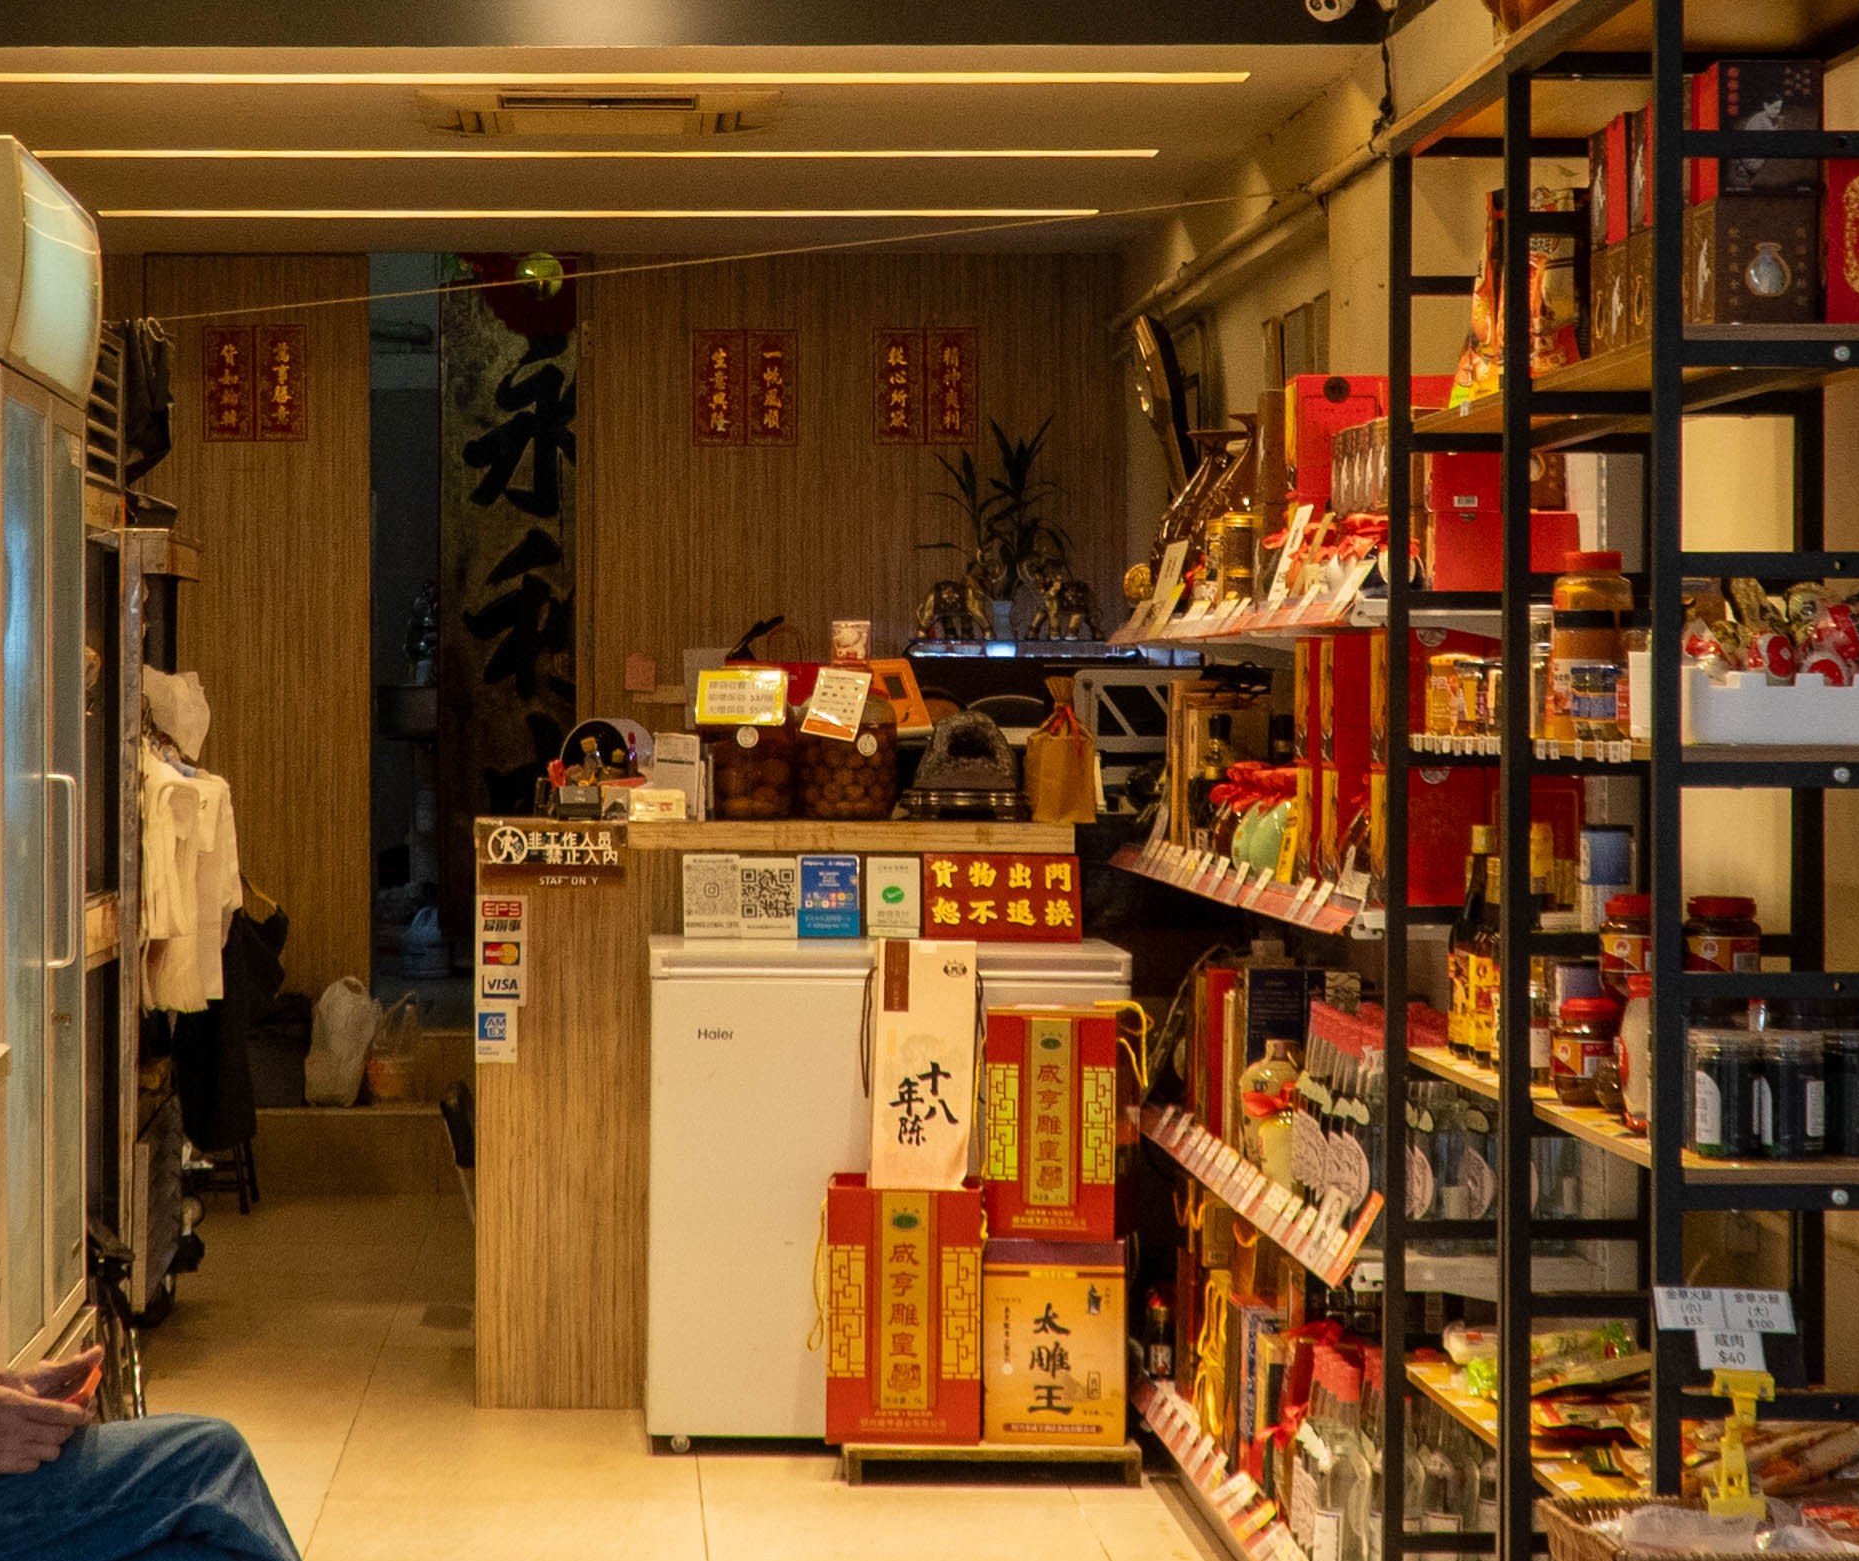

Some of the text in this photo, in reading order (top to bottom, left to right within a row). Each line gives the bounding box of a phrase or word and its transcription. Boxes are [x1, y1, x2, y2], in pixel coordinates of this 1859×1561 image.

[762, 350, 783, 430] 一帆風順
[930, 860, 1072, 892] 貨物出門
[483, 902, 521, 917] EPS
[931, 900, 1077, 929] 恕不退換
[487, 978, 519, 991] VISA
[697, 1027, 734, 1041] Haier
[1717, 1350, 1746, 1366] $40
